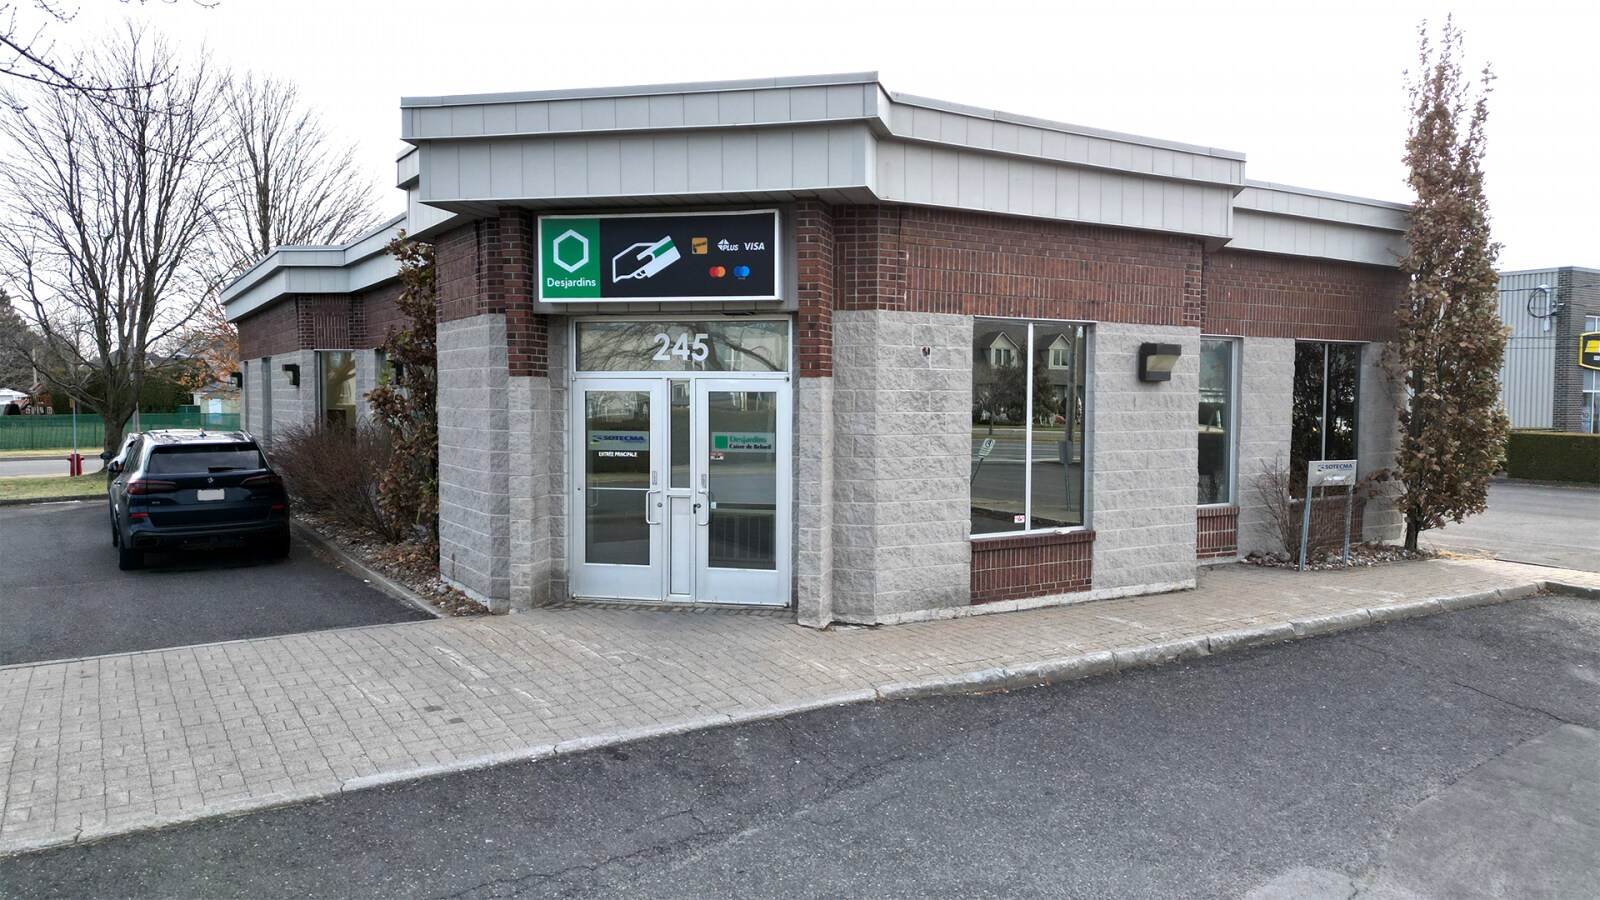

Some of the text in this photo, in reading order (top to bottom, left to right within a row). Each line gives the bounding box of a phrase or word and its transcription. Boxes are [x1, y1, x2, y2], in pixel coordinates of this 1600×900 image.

[744, 242, 765, 251] VISA
[547, 277, 597, 289] Desjardins
[653, 333, 709, 362] 245
